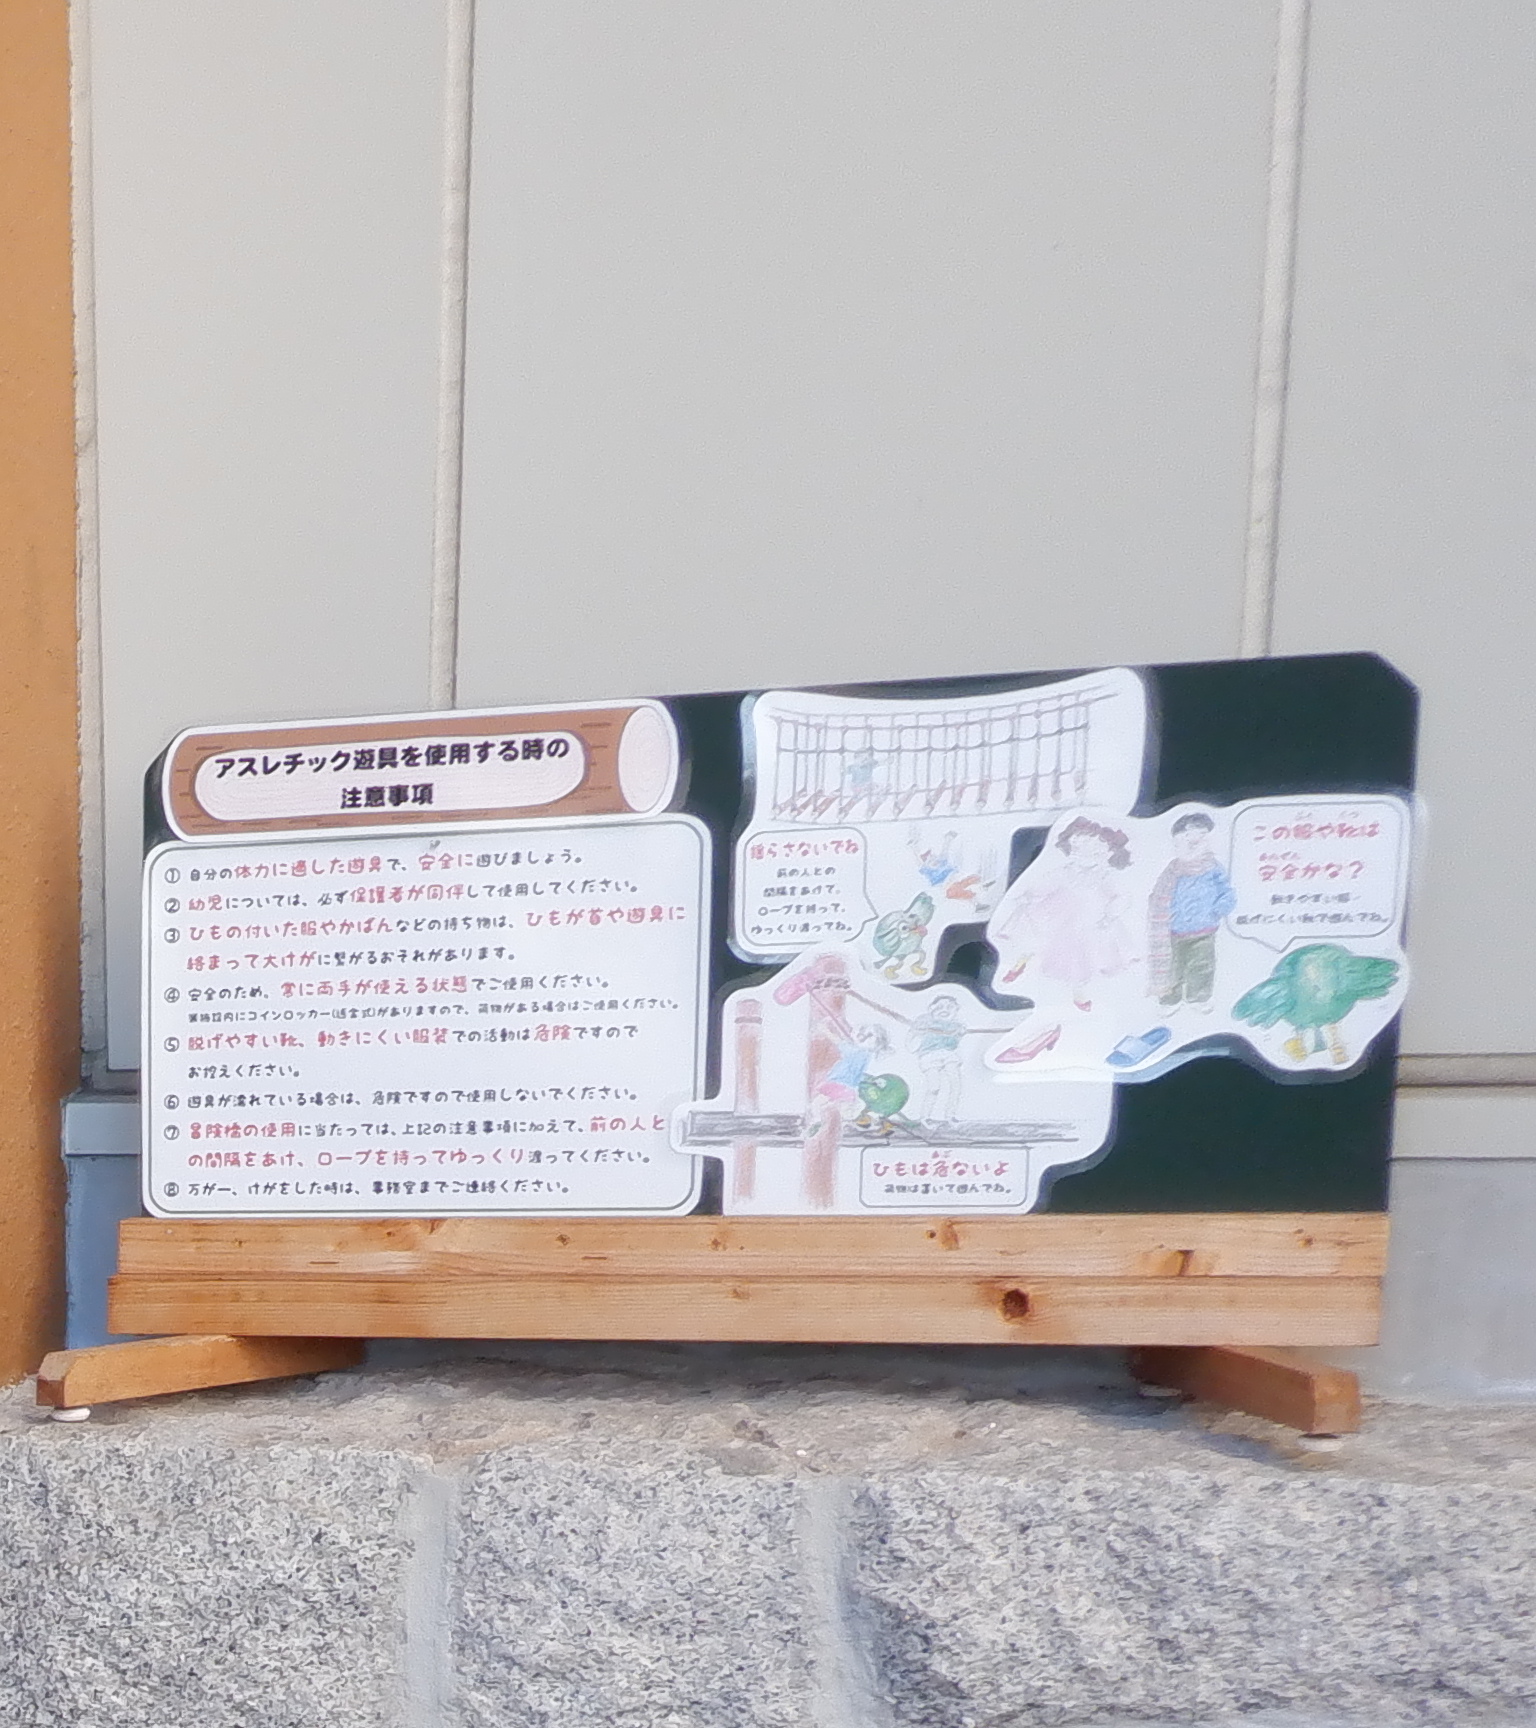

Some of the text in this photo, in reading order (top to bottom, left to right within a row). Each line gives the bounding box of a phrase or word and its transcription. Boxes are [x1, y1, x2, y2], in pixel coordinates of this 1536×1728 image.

[214, 738, 570, 779] アスレチック遊具を使用する時の
[340, 783, 434, 809] 注意事項
[190, 849, 582, 882] 自分の体力に適した遊具で、安全に遊びましょう。
[188, 1064, 300, 1080] お控えください。
[873, 1160, 1010, 1178] ひもは危ないよ
